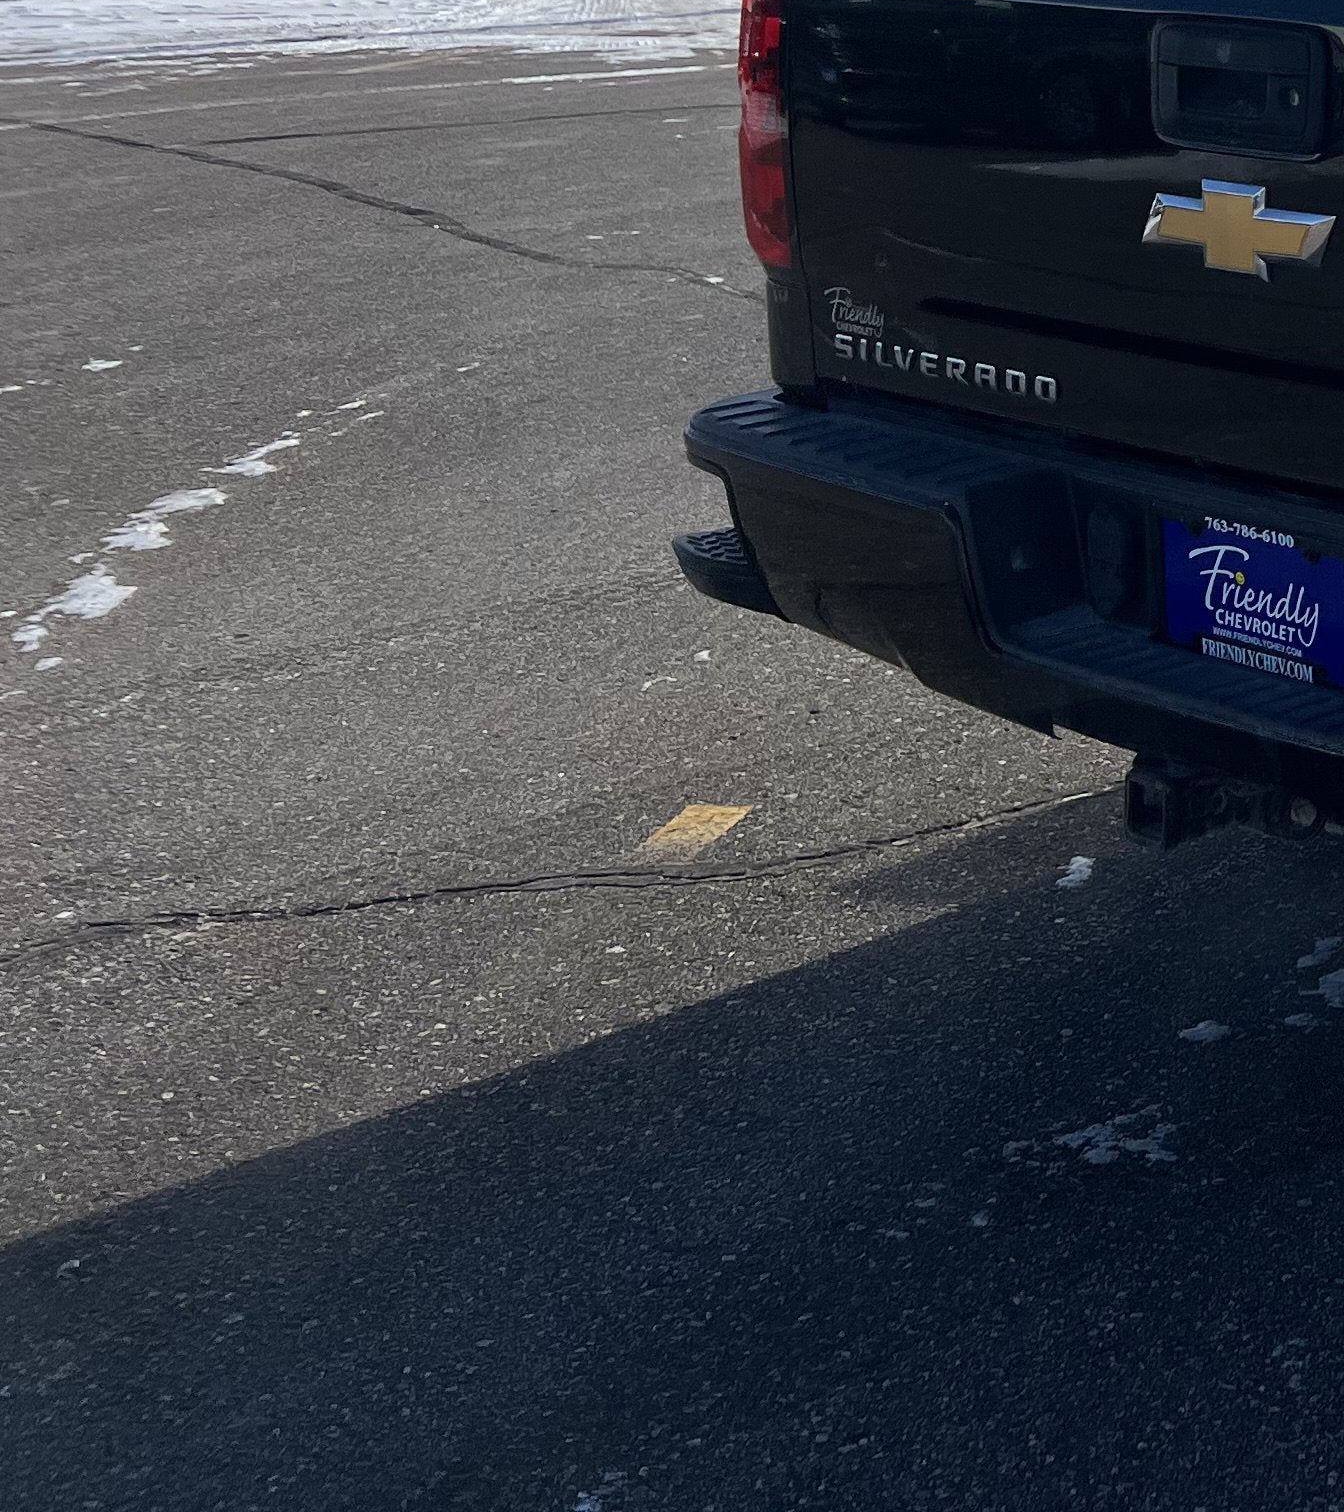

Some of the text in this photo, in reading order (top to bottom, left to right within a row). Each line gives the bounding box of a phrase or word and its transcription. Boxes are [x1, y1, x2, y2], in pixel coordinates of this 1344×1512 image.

[824, 287, 884, 338] Friendly
[834, 334, 1057, 403] SILVERADO
[1204, 517, 1294, 548] 763-786-6100
[1189, 546, 1319, 647] Friendly
[1215, 609, 1296, 642] CHEVROLET
[1202, 637, 1313, 683] FRIENDLYCHEV.COM
